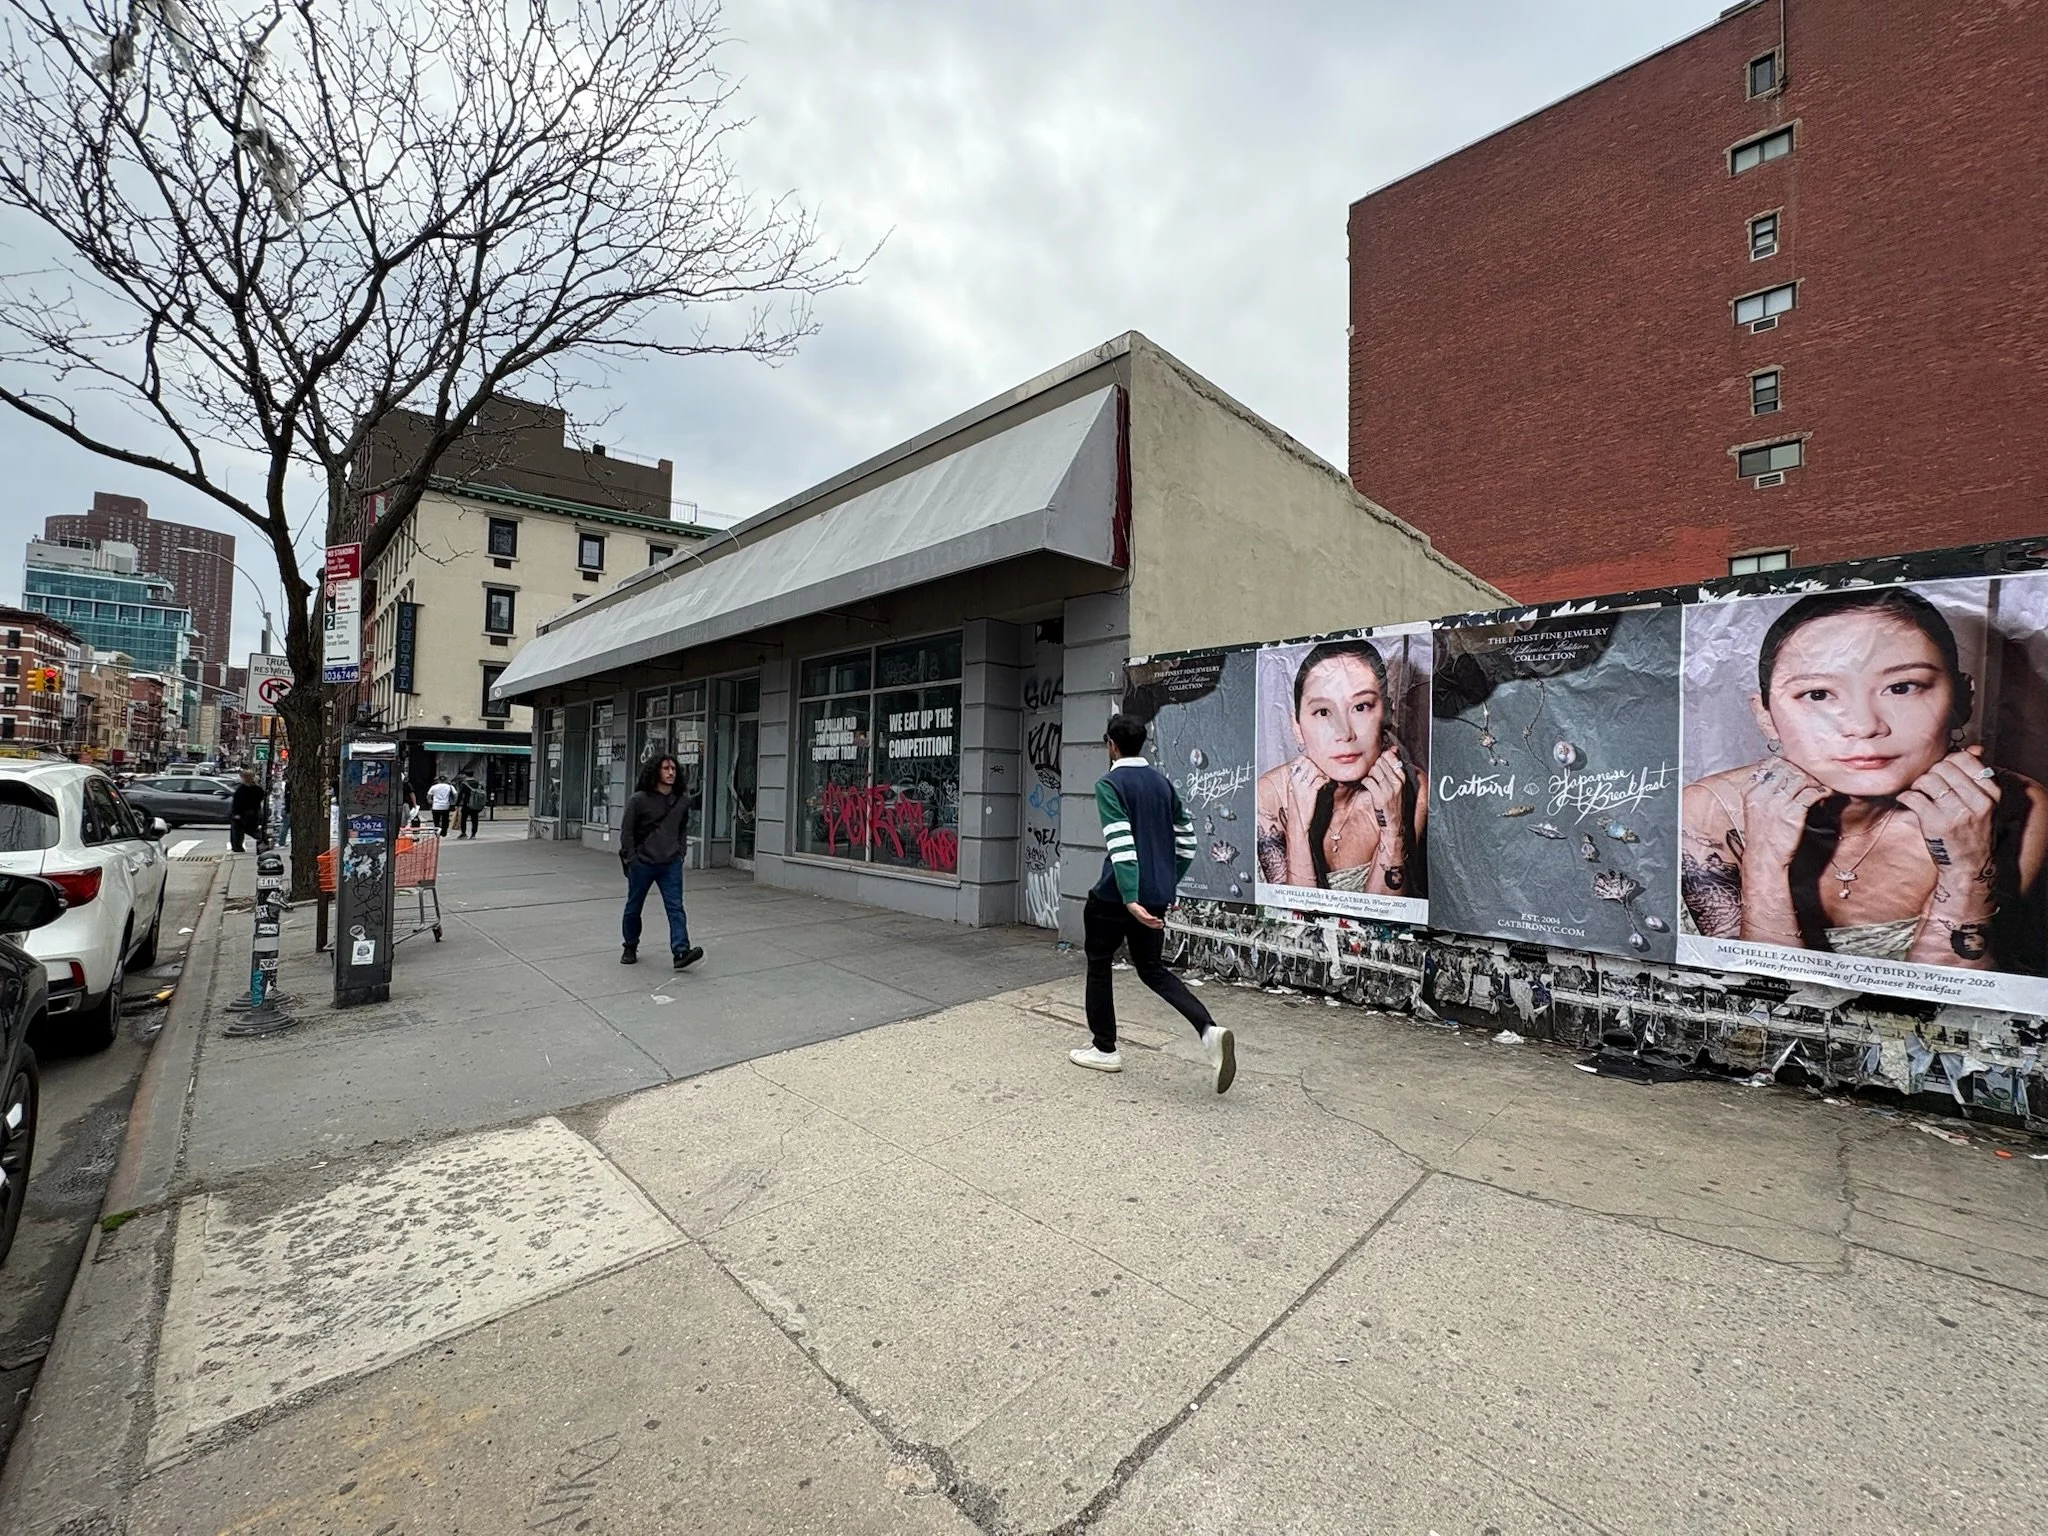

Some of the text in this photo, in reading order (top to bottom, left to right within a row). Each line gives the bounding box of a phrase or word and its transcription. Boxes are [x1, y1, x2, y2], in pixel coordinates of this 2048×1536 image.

[327, 615, 334, 630] 2
[1488, 627, 1609, 645] THE FINEST FINE JEWELRY
[400, 606, 413, 689] SOHOTEL
[1502, 640, 1589, 656] A Limited Edition
[266, 657, 289, 668] TRUC
[1514, 651, 1577, 663] COLLECTION
[324, 670, 351, 681] 103674
[1165, 669, 1184, 677] FINEST
[1195, 665, 1220, 674] JEWELRY
[1168, 683, 1203, 691] COLLECTION
[889, 707, 953, 733] WE EAT UP THE
[889, 735, 953, 759] COMPETITION!
[1439, 773, 1516, 801] Catbird
[1574, 761, 1680, 825] Breakfast
[352, 821, 382, 830] 103674
[1275, 889, 1306, 897] MICHELLE
[1330, 894, 1339, 902] for
[1372, 899, 1393, 907] Winter
[1335, 901, 1341, 909] of
[1364, 905, 1389, 914] Breakfast
[1521, 913, 1561, 925] EST. 2004
[1497, 919, 1585, 937] CATBIRDNYC.COM
[1717, 945, 1996, 988] MICHELLE ZAUNER for CATBIRD, Winter 2026
[1745, 958, 1962, 996] Writer, frontwoman of Japanese Breakfast
